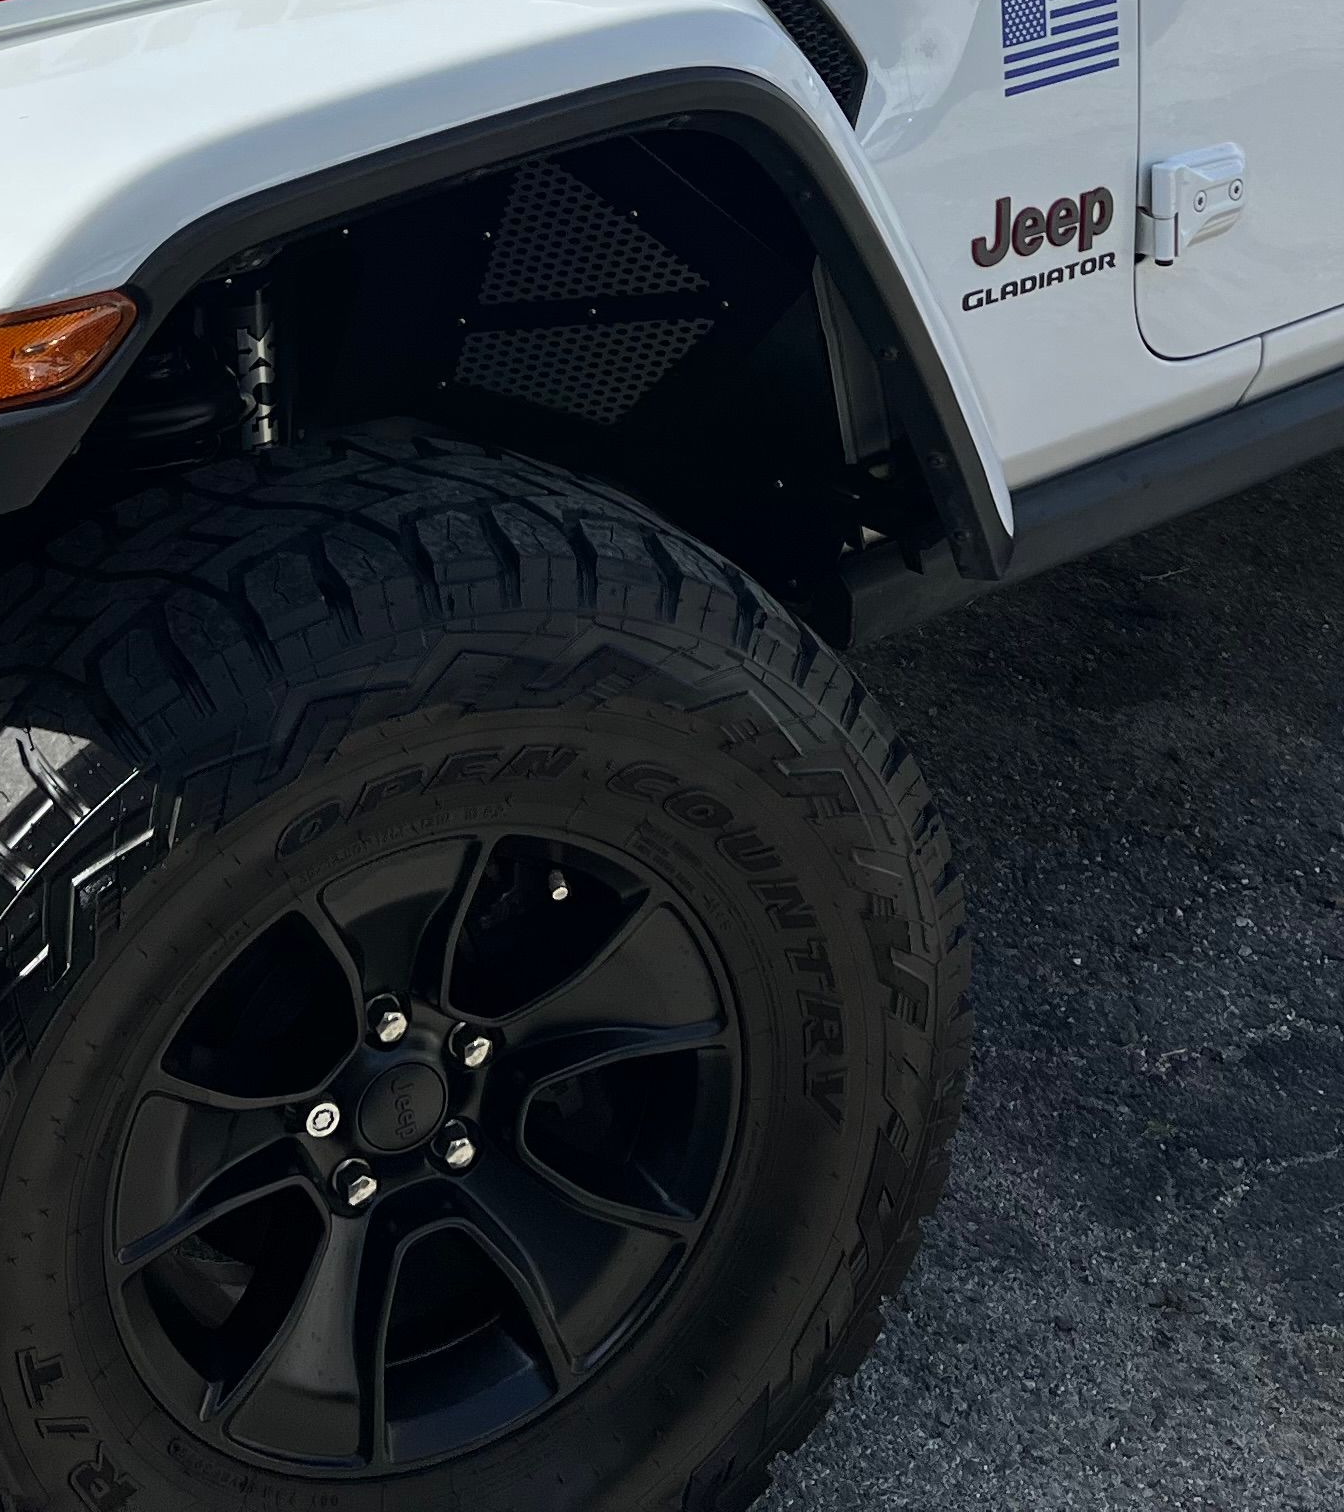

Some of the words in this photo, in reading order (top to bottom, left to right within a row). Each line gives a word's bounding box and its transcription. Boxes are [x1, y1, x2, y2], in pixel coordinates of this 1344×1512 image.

[971, 186, 1114, 268] Jeep
[961, 251, 1117, 312] GLADIATOR
[274, 742, 586, 860] OPEN
[606, 759, 849, 1134] COUNTRY
[390, 1075, 416, 1140] Jeep
